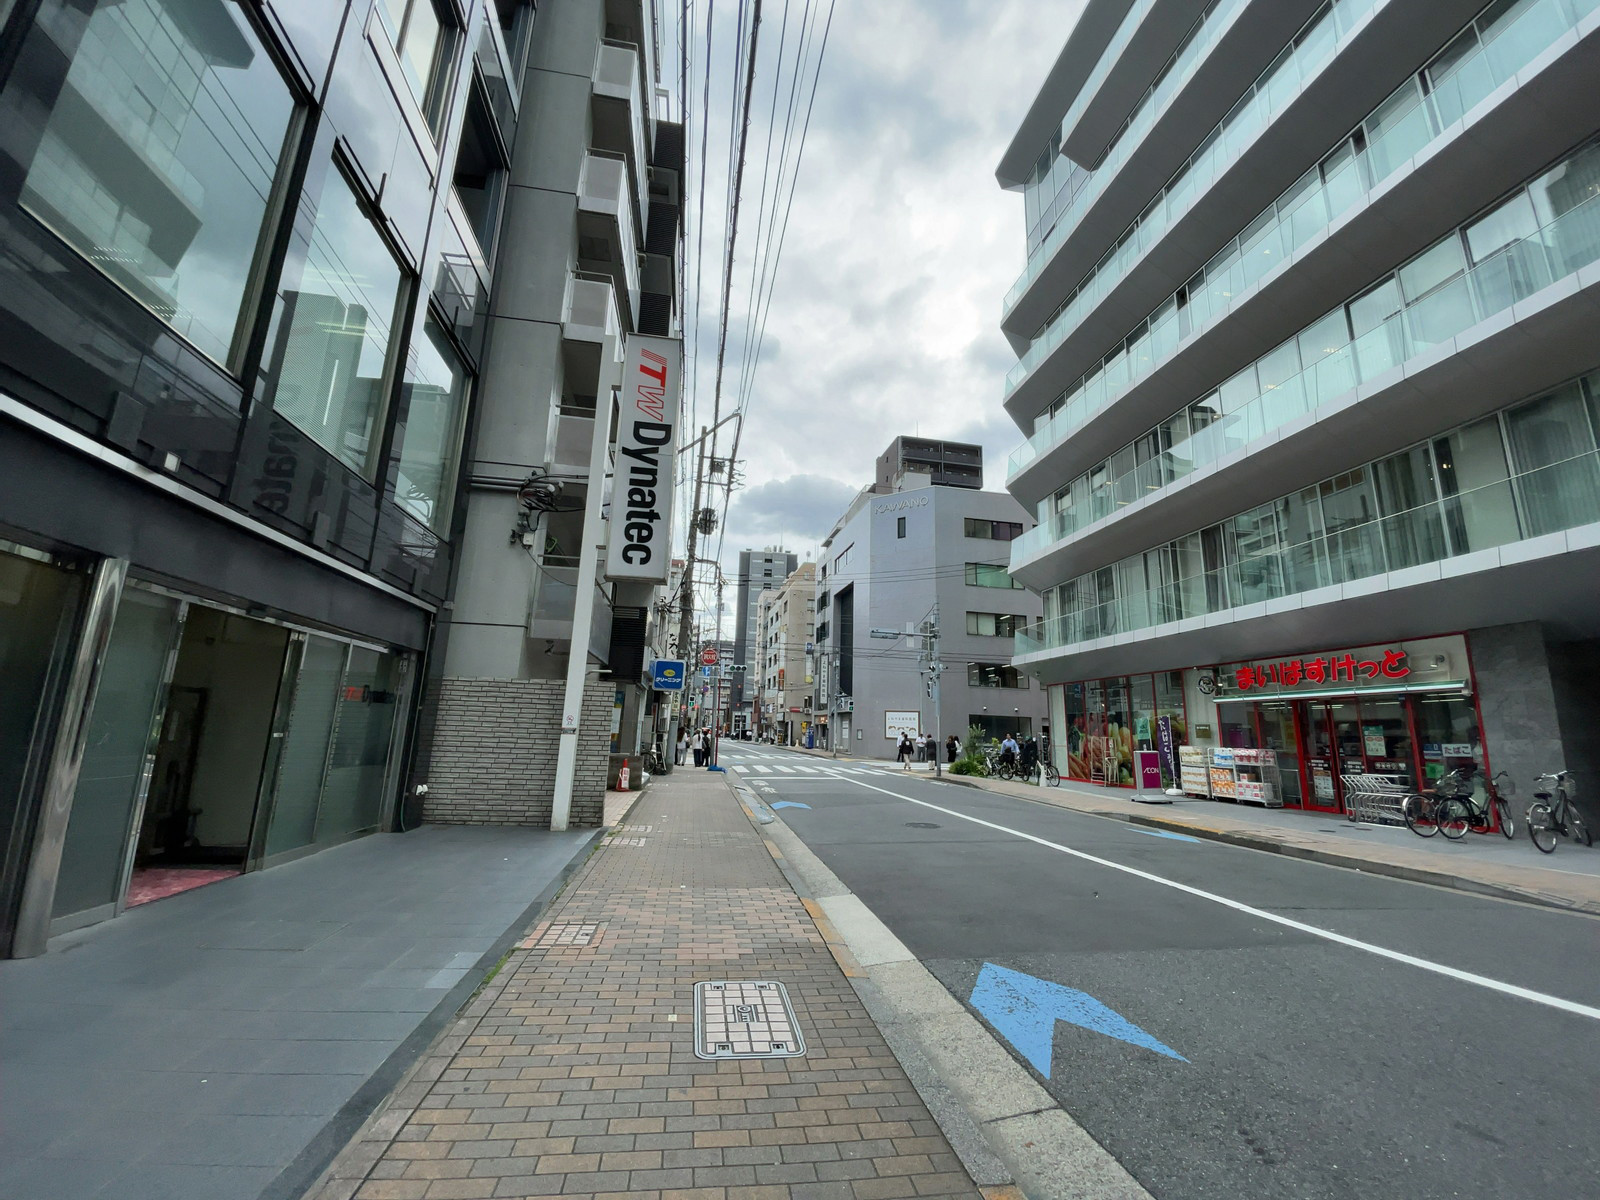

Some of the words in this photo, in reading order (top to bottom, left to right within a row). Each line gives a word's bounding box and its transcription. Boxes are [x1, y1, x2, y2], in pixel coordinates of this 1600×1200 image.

[636, 348, 668, 423] ITW
[621, 420, 673, 566] Dynatec
[874, 495, 930, 514] KAWANO
[1235, 649, 1412, 691] まいばすけっと
[1444, 745, 1471, 755] たばこ
